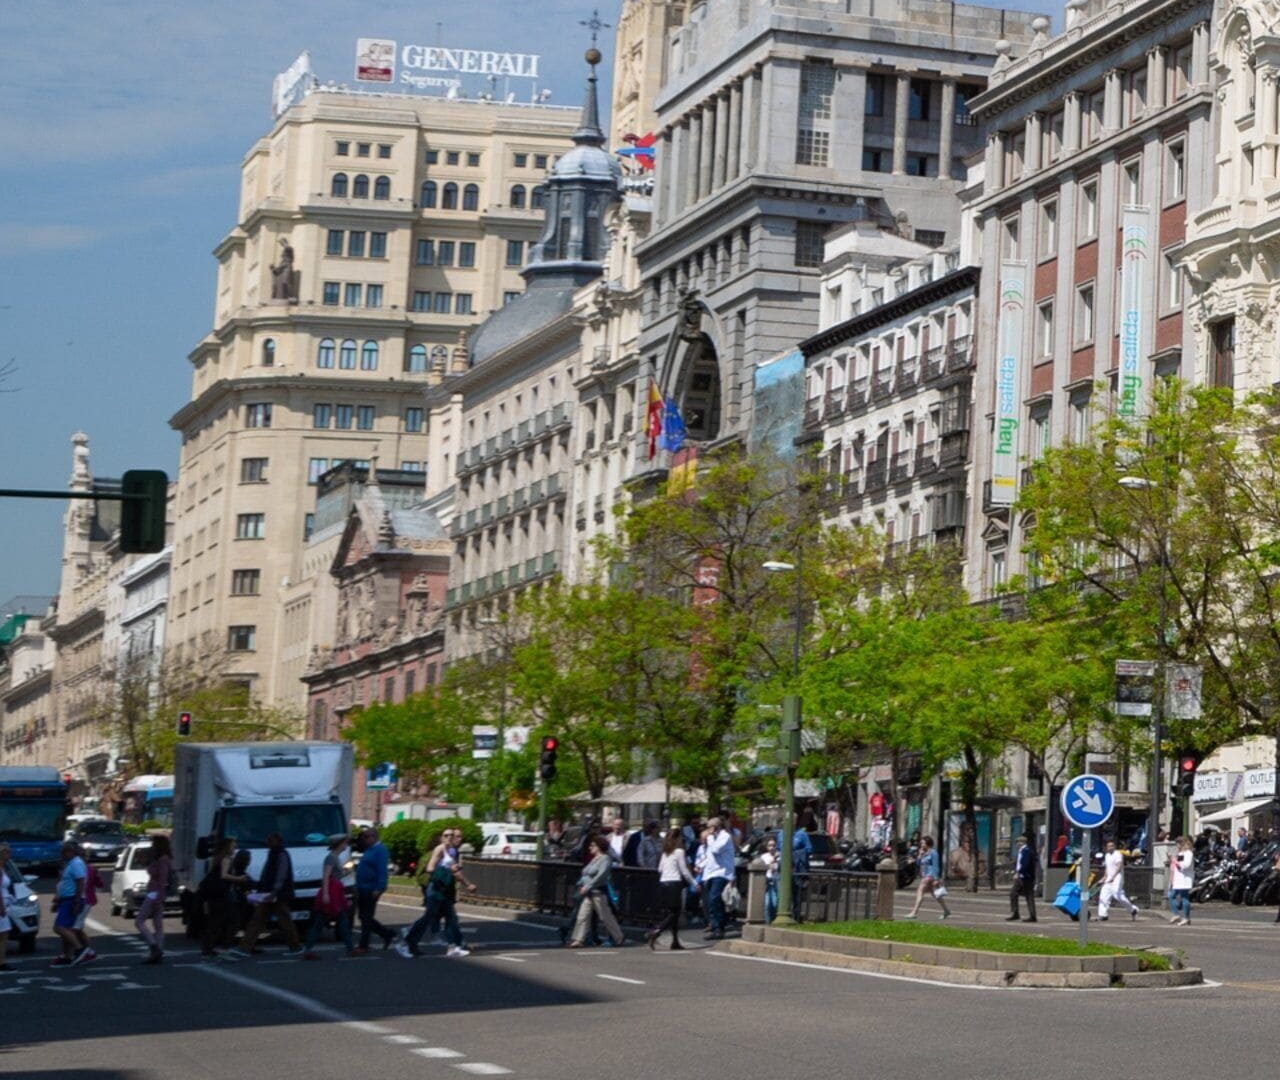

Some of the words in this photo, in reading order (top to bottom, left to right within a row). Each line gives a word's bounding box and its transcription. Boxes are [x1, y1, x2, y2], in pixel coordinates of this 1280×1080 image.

[401, 44, 542, 78] GENERALI
[400, 70, 462, 89] Seguros
[1122, 311, 1139, 370] salida
[998, 357, 1016, 414] salida
[1119, 375, 1142, 416] hay
[995, 417, 1018, 455] hay
[1197, 777, 1222, 791] OUTLET
[1250, 772, 1275, 785] OUTLE
